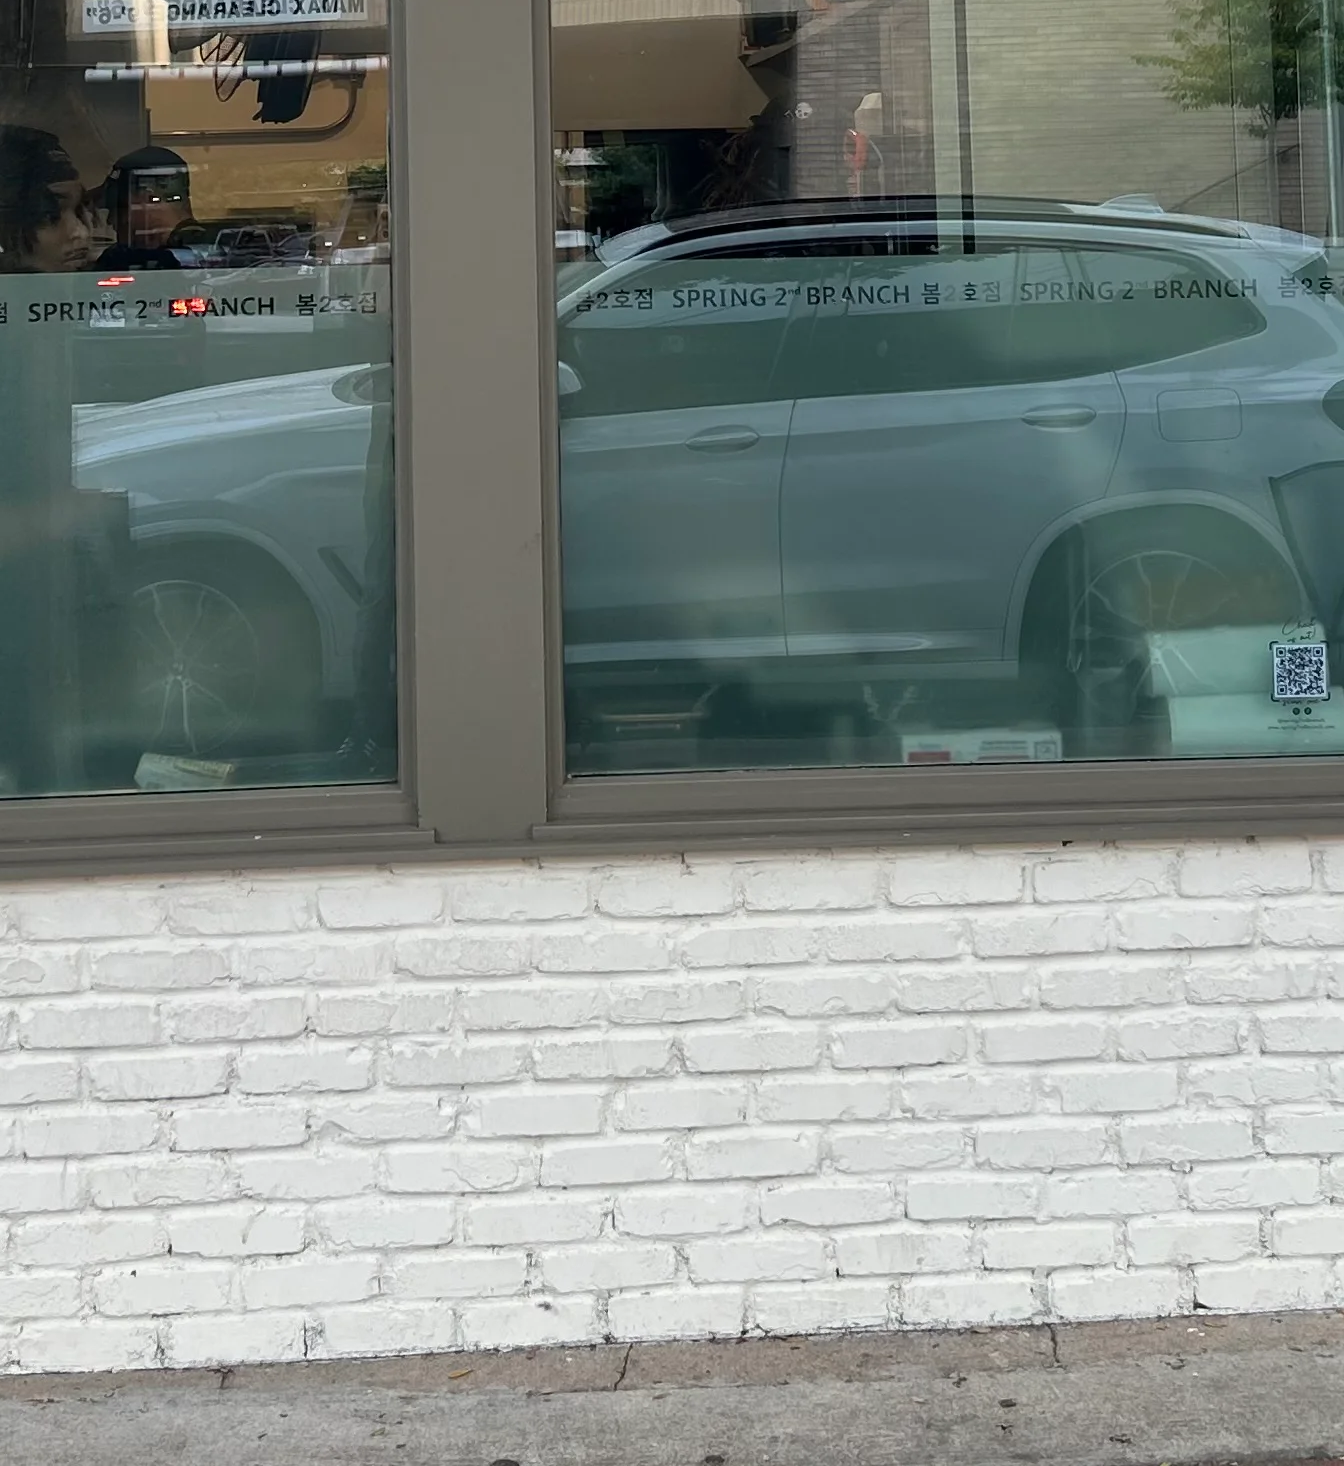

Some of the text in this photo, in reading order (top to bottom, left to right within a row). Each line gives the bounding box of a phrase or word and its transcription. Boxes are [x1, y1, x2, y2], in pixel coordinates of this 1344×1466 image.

[672, 288, 766, 309] SPRING
[807, 284, 911, 307] BRANCH
[1019, 280, 1114, 303] SPRING
[1153, 278, 1258, 300] BRANCH
[28, 300, 127, 323] SPRING
[168, 296, 275, 319] BRANCH
